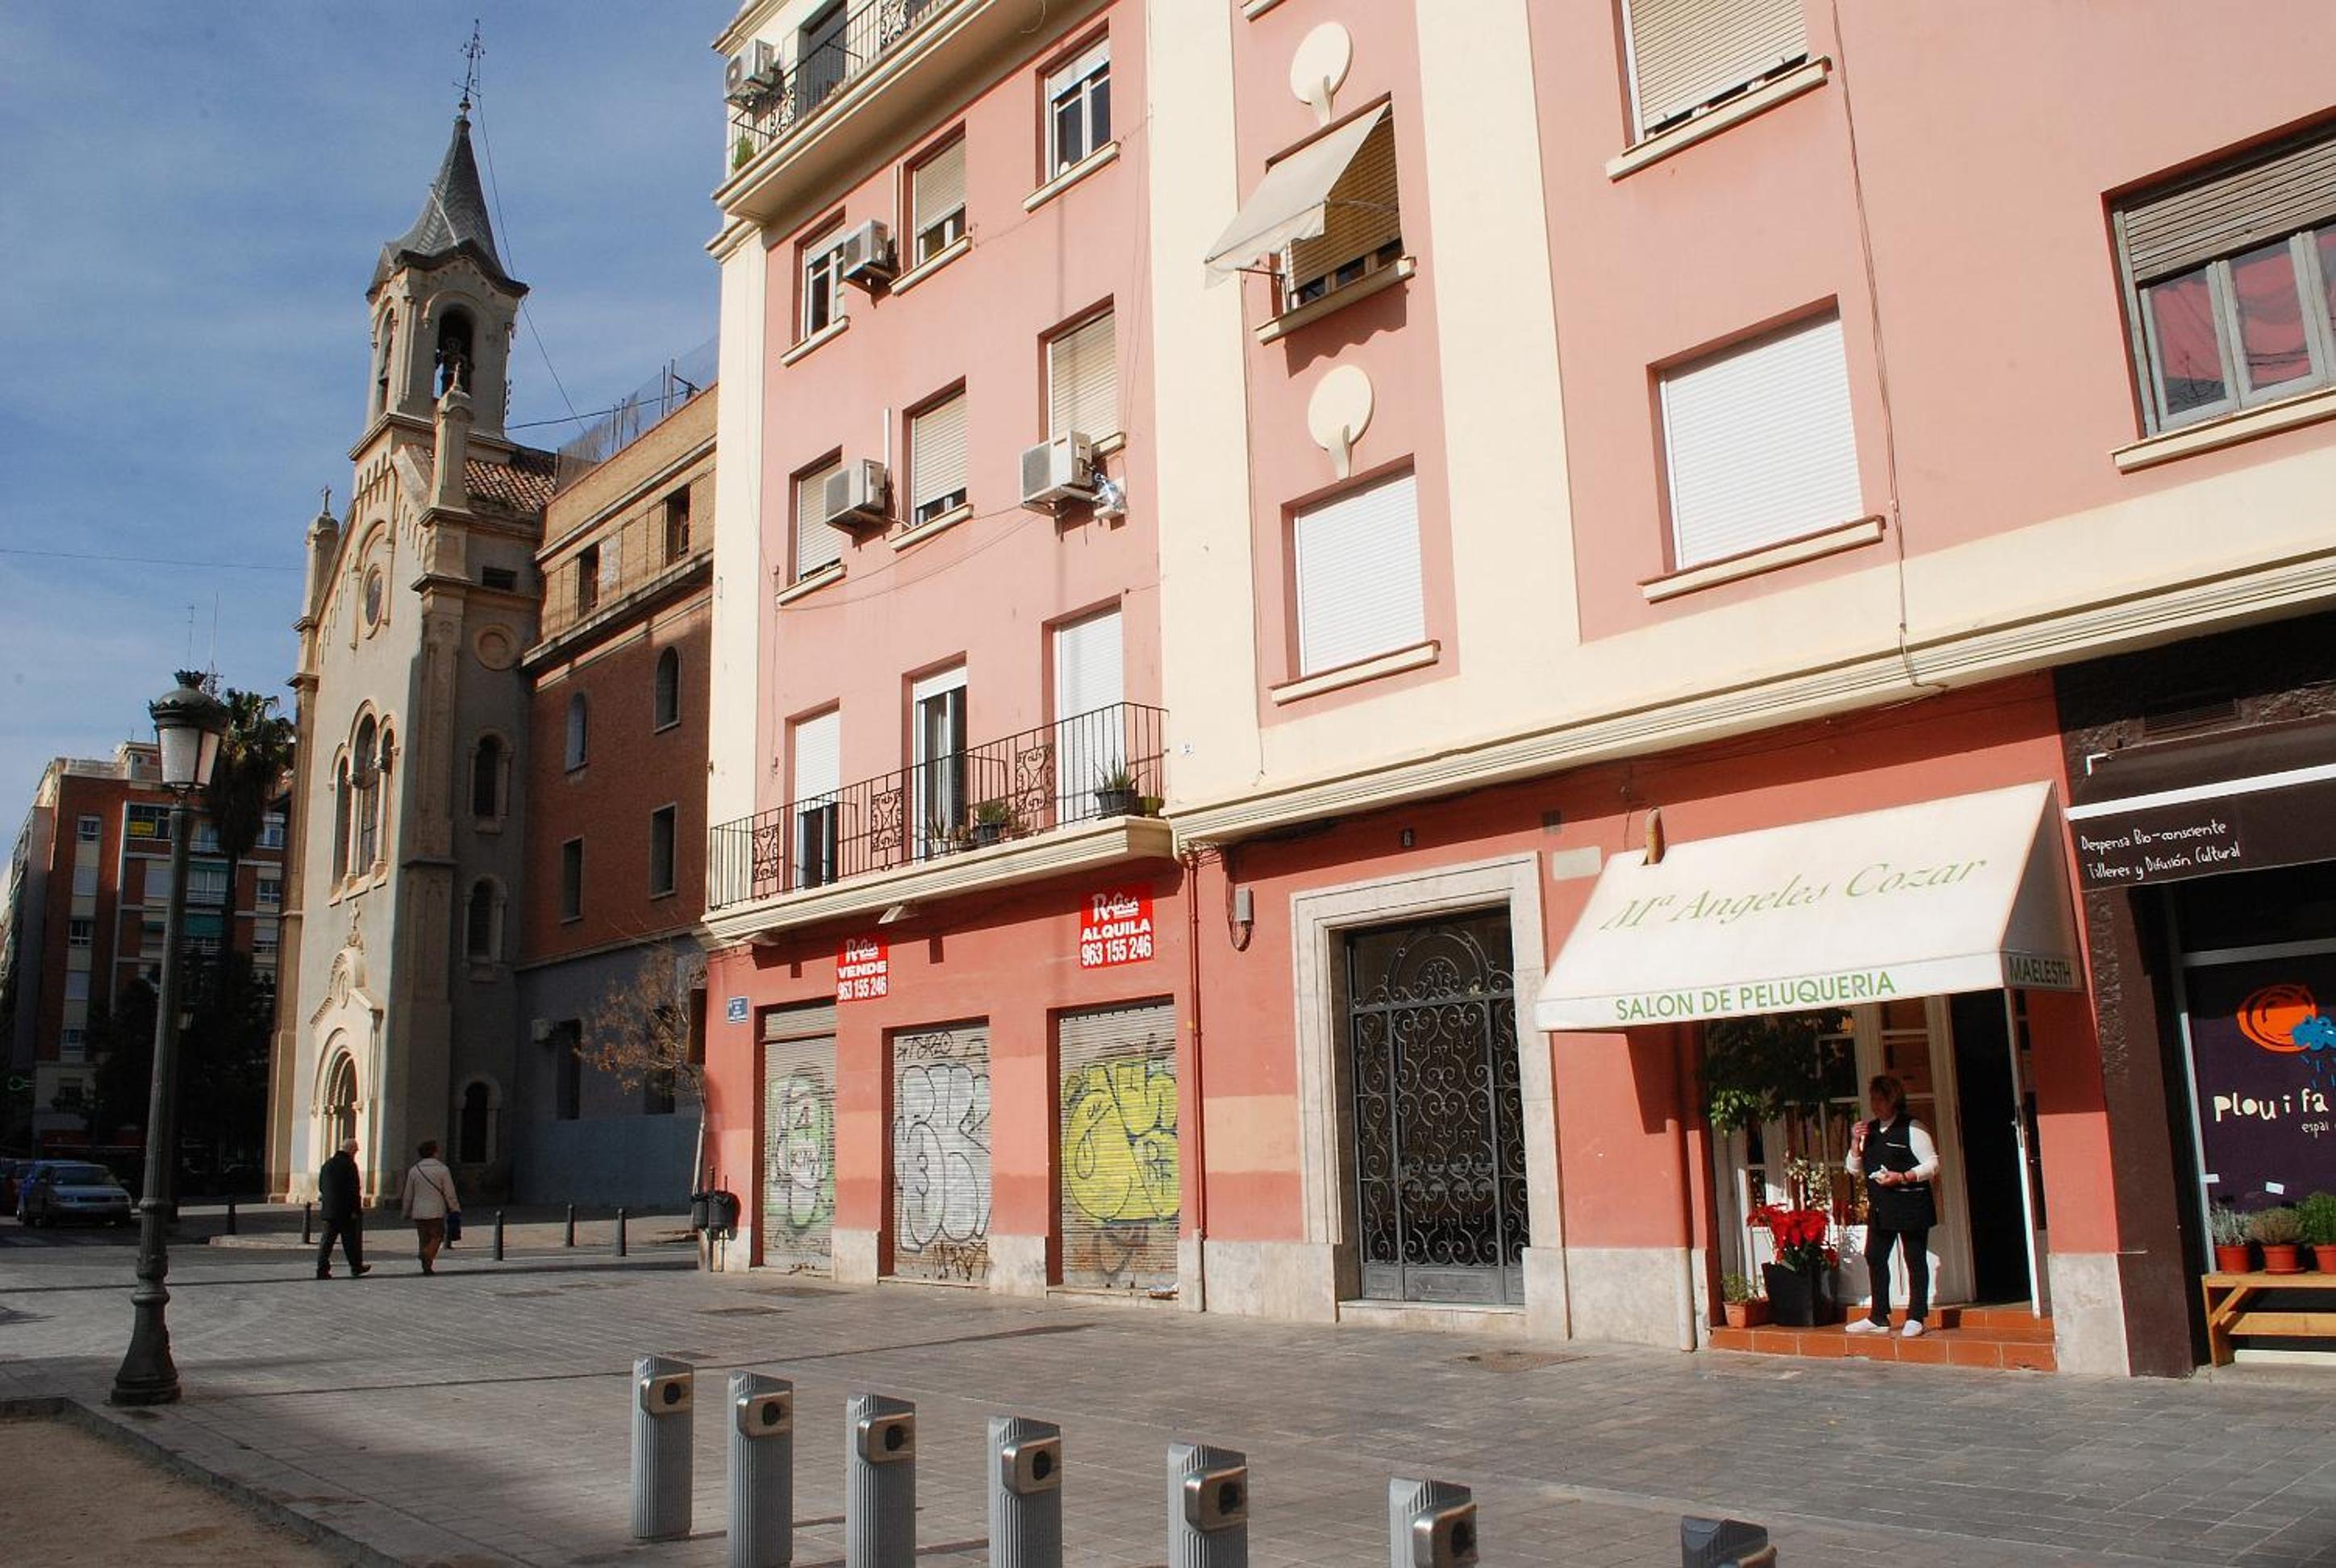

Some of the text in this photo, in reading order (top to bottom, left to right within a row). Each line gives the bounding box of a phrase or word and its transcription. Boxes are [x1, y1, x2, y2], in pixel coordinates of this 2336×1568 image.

[2081, 819, 2226, 855] Despensa Bio-consciente
[2135, 867, 2144, 880] y
[2146, 854, 2192, 872] Difusión
[2195, 840, 2240, 863] Cultural
[1668, 874, 1829, 925] Angeles
[1846, 859, 1987, 897] Cozar
[1082, 918, 1151, 942] ALQUILA
[1082, 934, 1151, 966] 963 155 246
[838, 960, 887, 979] VENDE
[838, 975, 886, 1000] 963 155 246
[1616, 971, 1896, 1020] SALON DE PELUQUERIA
[2283, 1095, 2291, 1114] i
[2301, 1088, 2330, 1113] fa
[2301, 1121, 2330, 1139] espai
